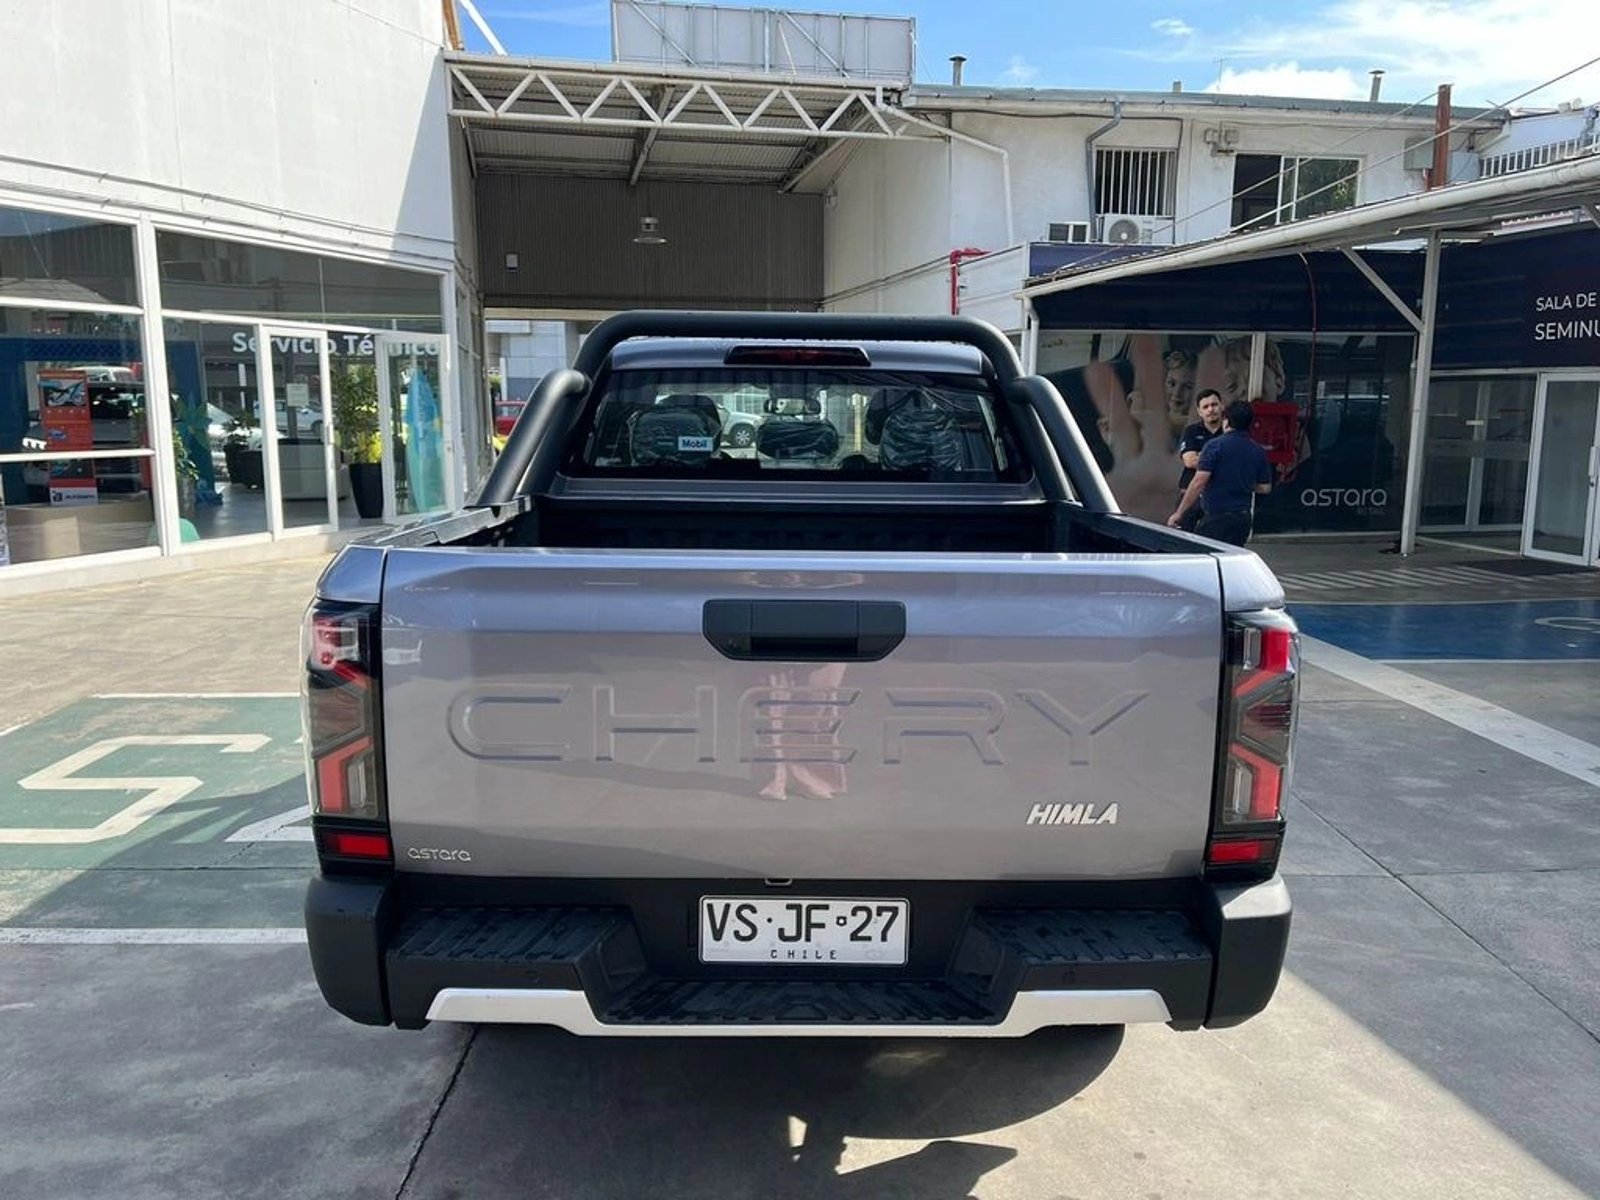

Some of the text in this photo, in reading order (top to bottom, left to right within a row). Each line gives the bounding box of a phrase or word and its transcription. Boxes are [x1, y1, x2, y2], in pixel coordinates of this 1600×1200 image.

[1536, 292, 1597, 311] SALA DE
[682, 439, 707, 449] Mobil
[1301, 488, 1387, 506] astara
[446, 682, 1151, 767] CHERY
[1026, 802, 1119, 825] HIMLA
[407, 847, 472, 861] astara
[770, 950, 837, 960] CHILE
